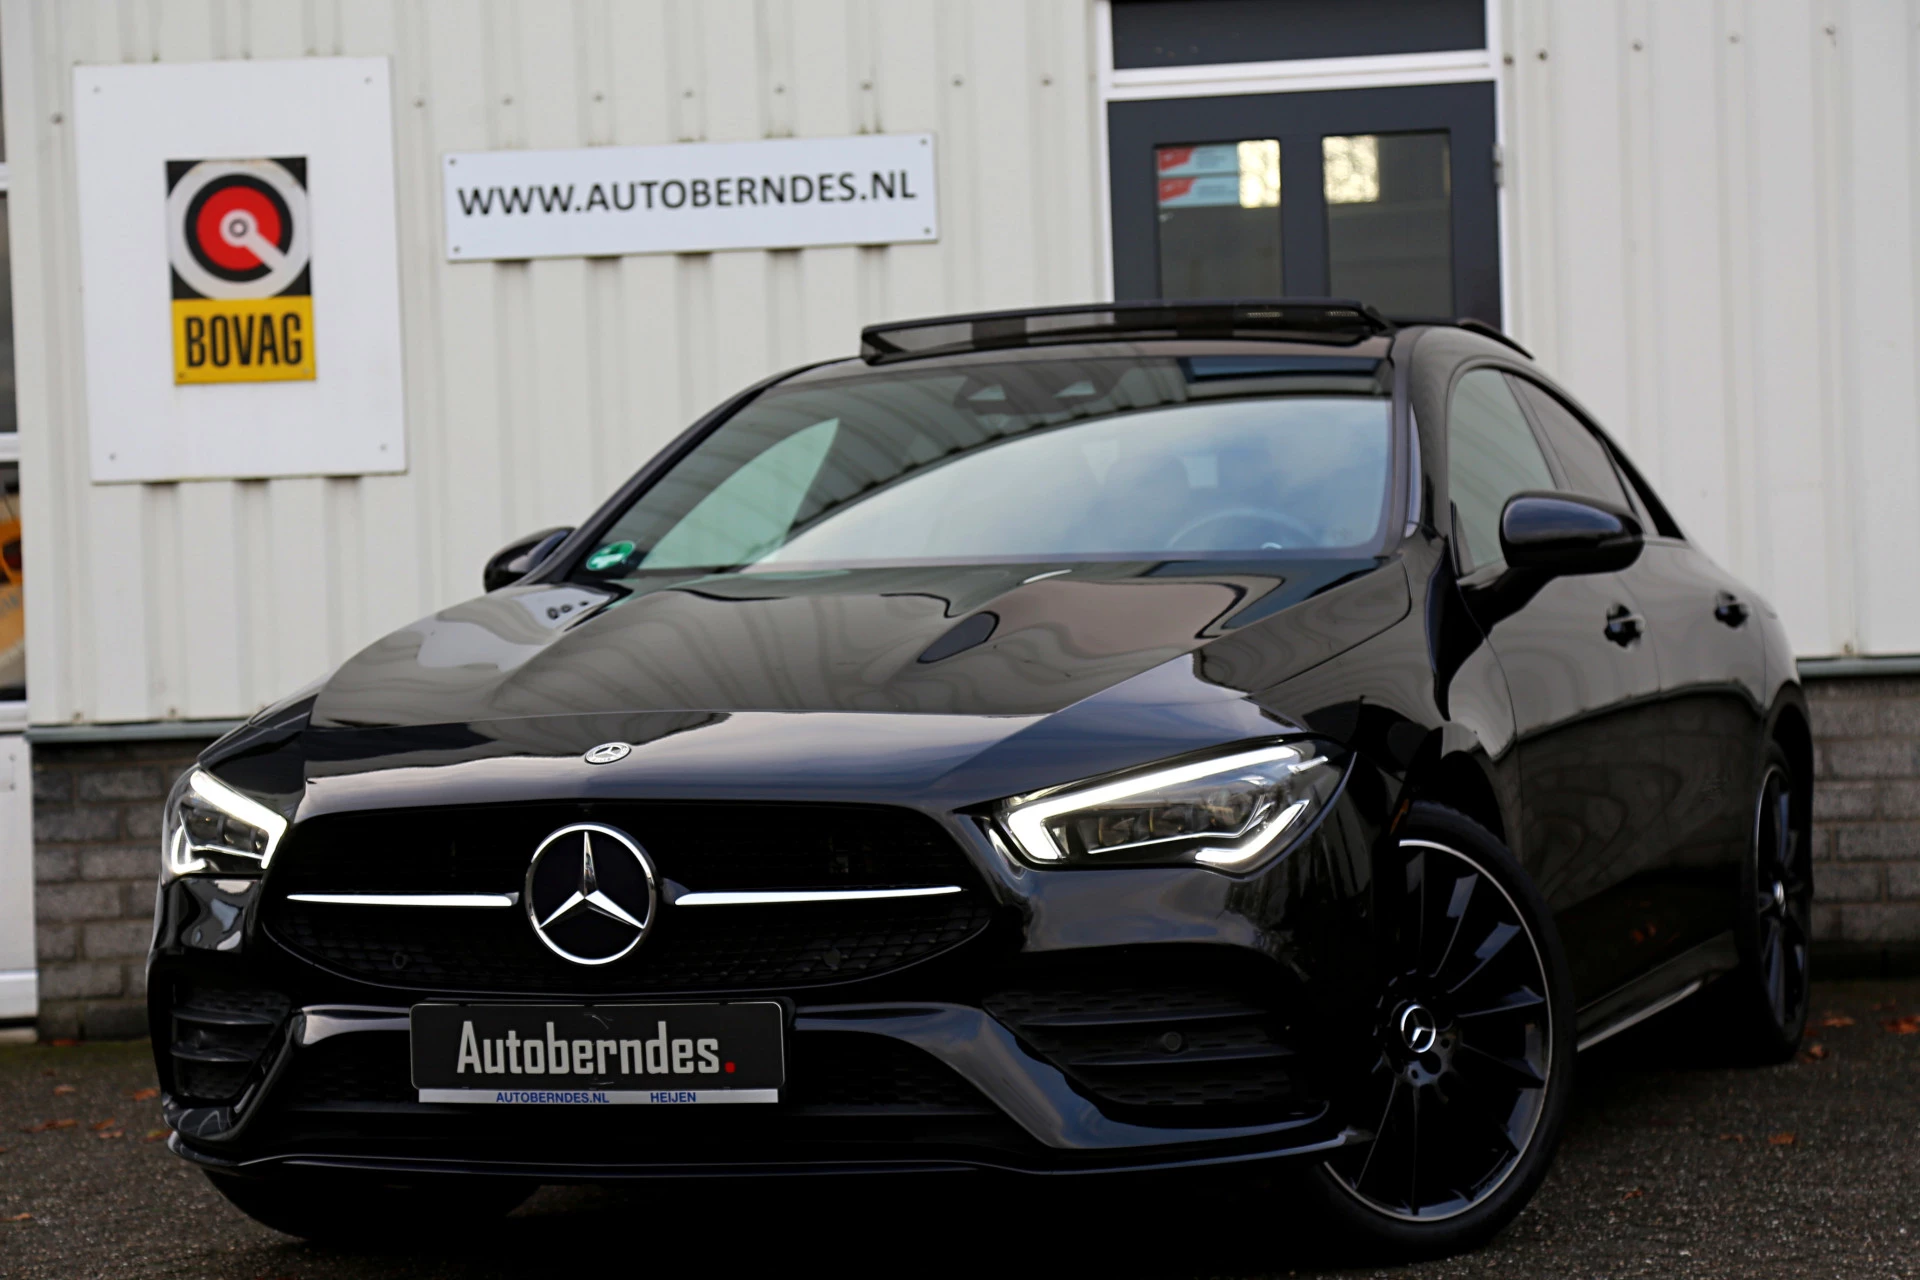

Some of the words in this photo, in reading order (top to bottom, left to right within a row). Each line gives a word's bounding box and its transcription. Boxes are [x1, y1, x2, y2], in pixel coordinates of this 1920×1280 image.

[457, 170, 916, 216] WWW.AUTOBERNDES.NL
[185, 312, 304, 369] BOVAG
[496, 1092, 609, 1104] AUTOBERNDES.NL
[650, 1092, 696, 1104] HEIJEN
